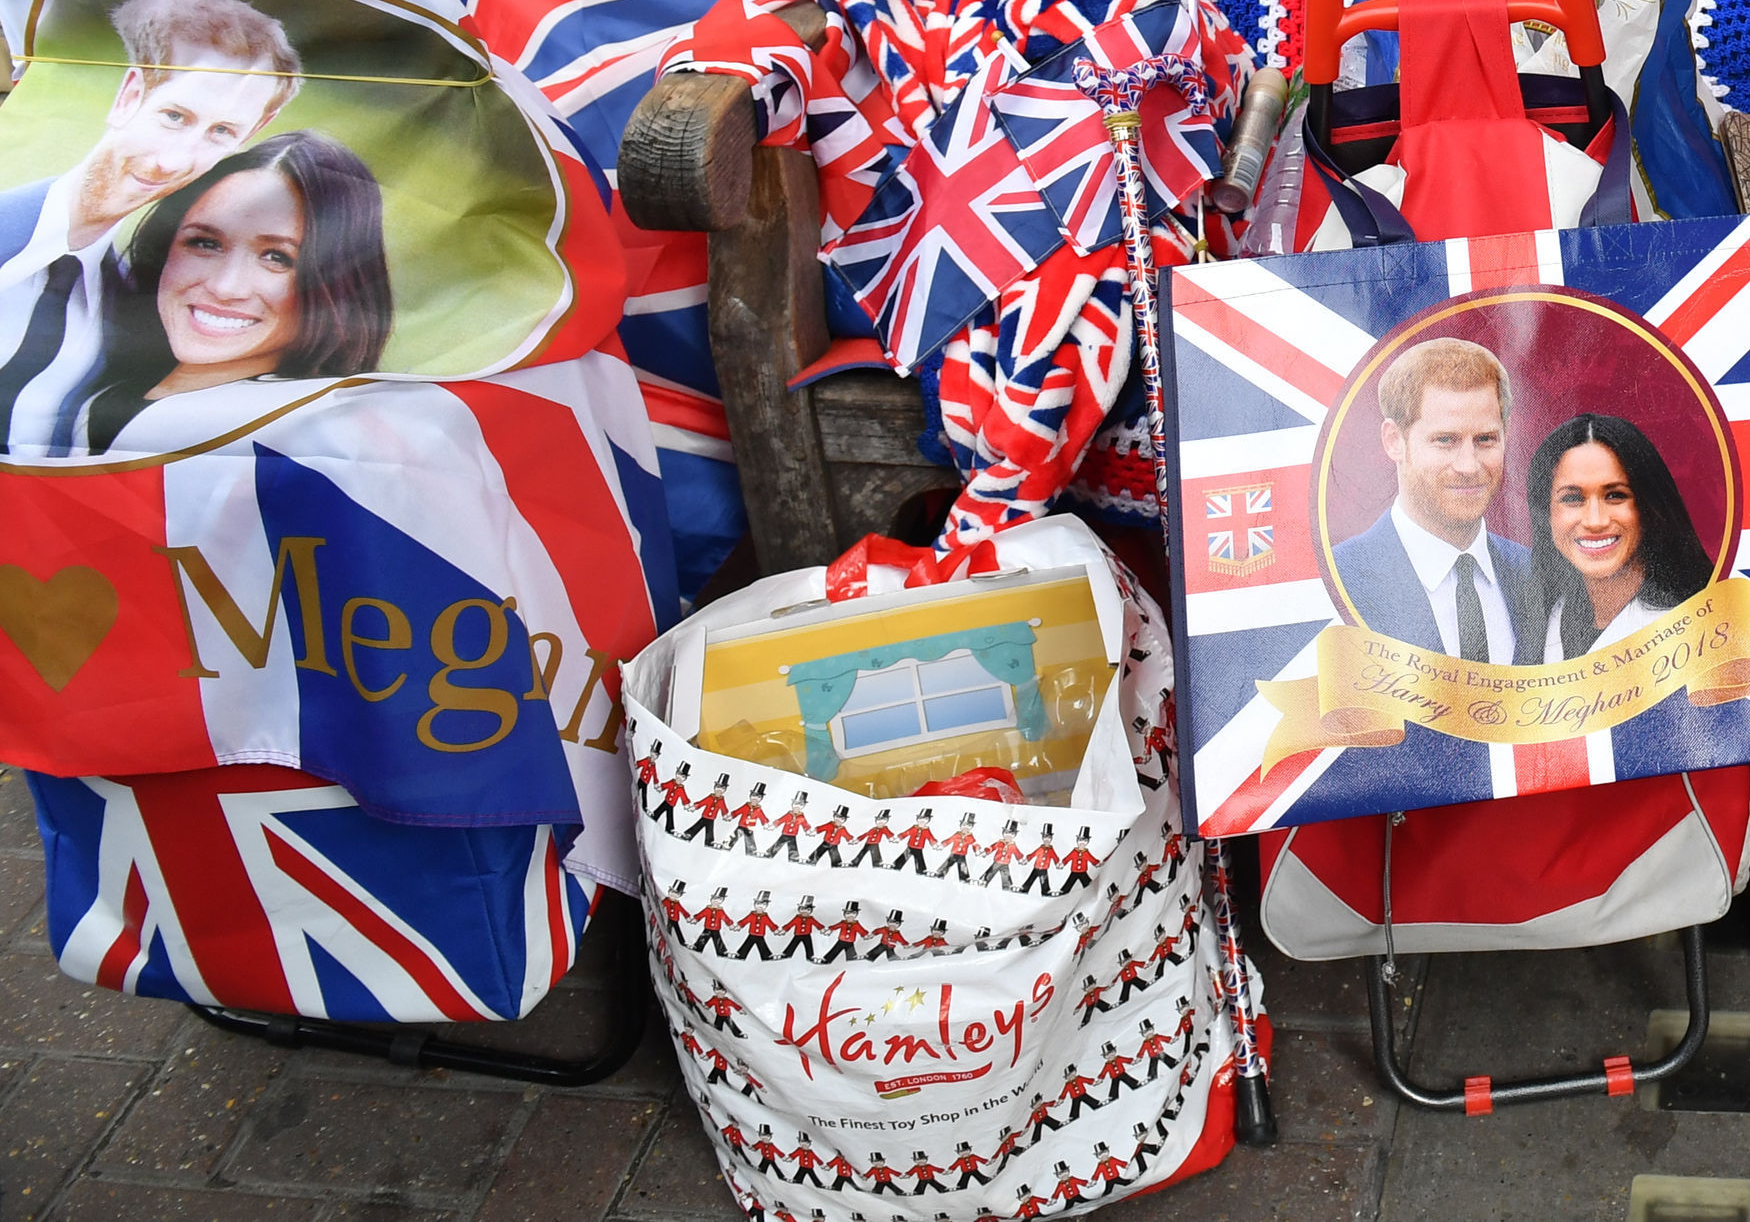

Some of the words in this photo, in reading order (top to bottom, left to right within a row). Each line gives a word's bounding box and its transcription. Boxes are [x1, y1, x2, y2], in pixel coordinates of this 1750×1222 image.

[1353, 664, 1453, 725] Harry
[1515, 683, 1645, 733] Meghan
[1651, 621, 1730, 687] 2018
[1363, 639, 1401, 664] The
[1405, 652, 1460, 684] Royal
[1466, 667, 1588, 694] Engagement
[1592, 661, 1610, 677] &
[1612, 614, 1693, 669] Marriage
[1696, 598, 1714, 619] of
[774, 970, 1056, 1081] Hamleys
[808, 1115, 837, 1128] The
[840, 1117, 886, 1131] Finest
[888, 1119, 916, 1131] Toy
[920, 1110, 960, 1123] Shop
[964, 1107, 979, 1117] in
[982, 1095, 1008, 1110] the
[1011, 1058, 1044, 1097] Wld
[884, 1079, 905, 1091] EST.
[907, 1074, 947, 1085] LONDON
[952, 1072, 974, 1081] 1760
